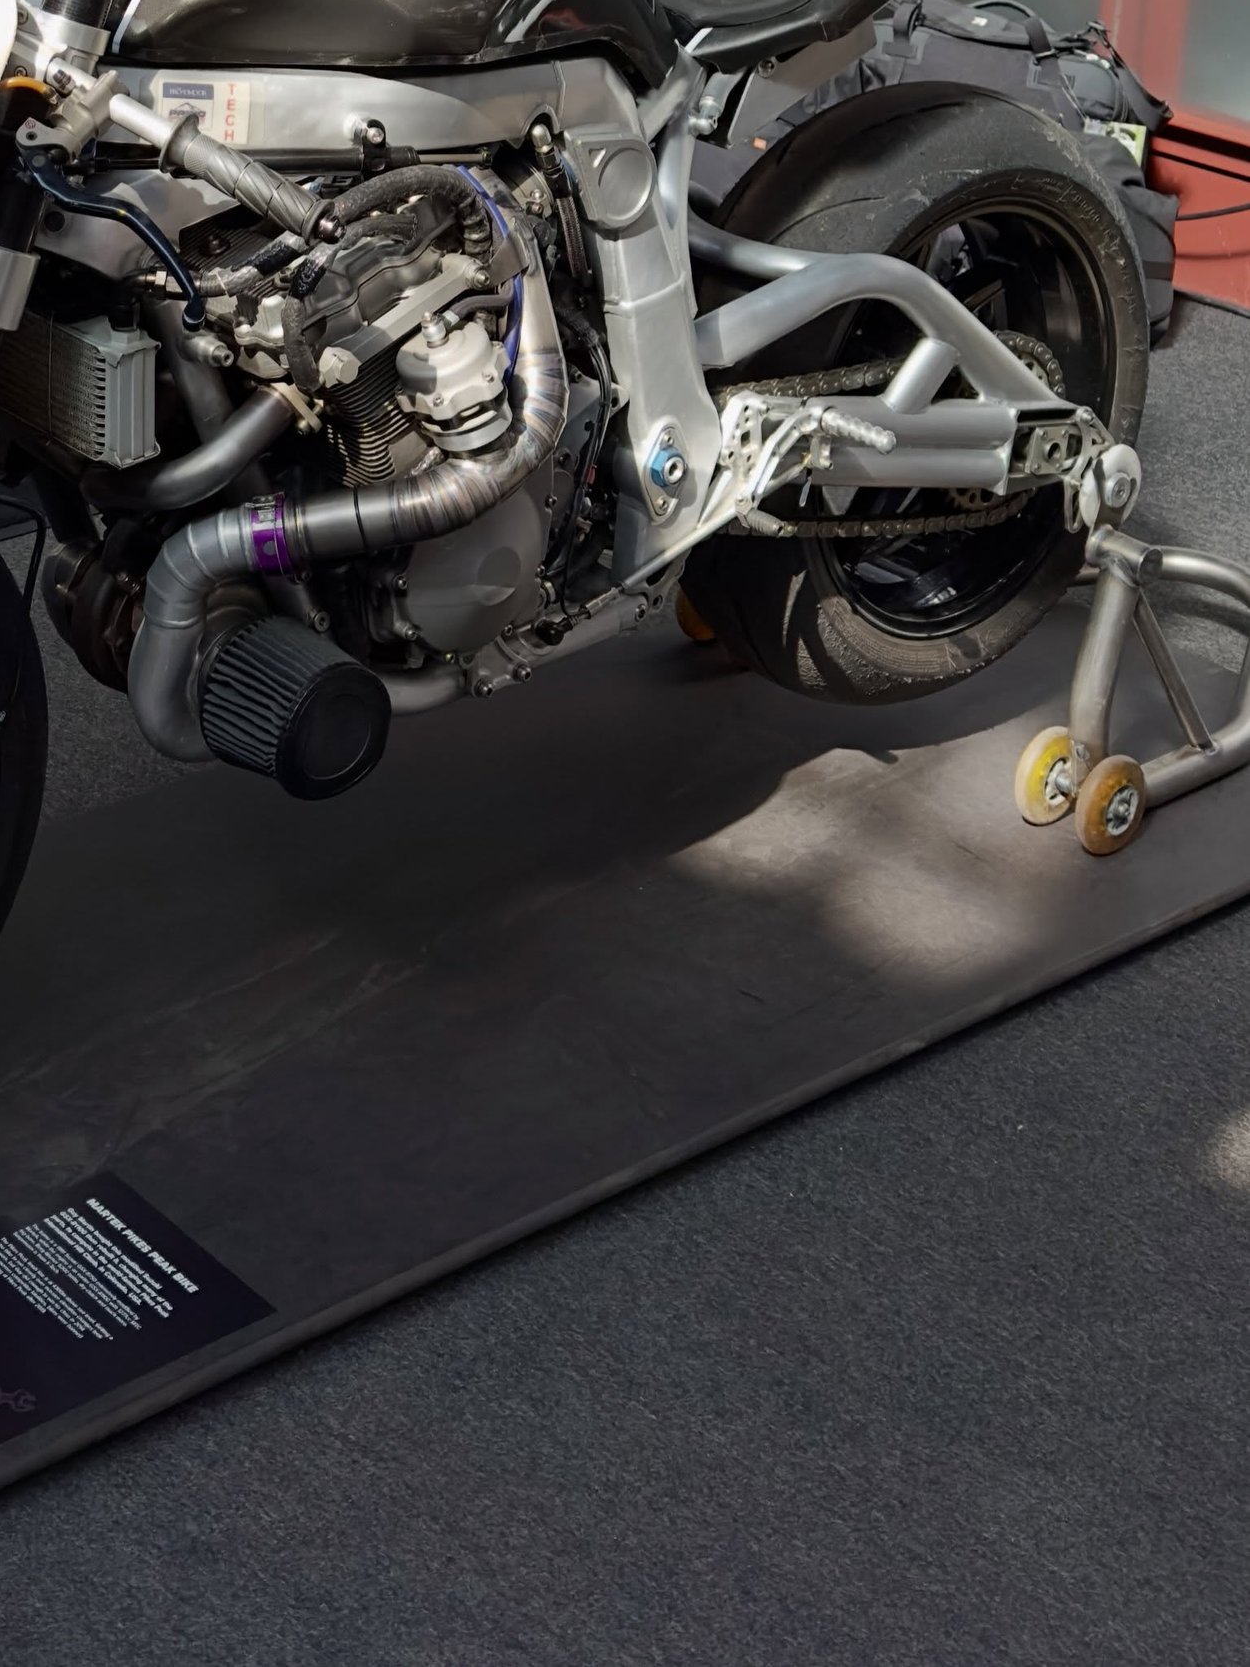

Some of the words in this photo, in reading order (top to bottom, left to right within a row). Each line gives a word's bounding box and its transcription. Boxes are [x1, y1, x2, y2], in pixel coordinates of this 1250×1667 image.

[224, 84, 236, 141] TECH
[86, 1198, 126, 1230] MARTEK
[122, 1229, 151, 1252] PIKES
[148, 1251, 176, 1274] PEAK
[172, 1272, 198, 1293] BIKE
